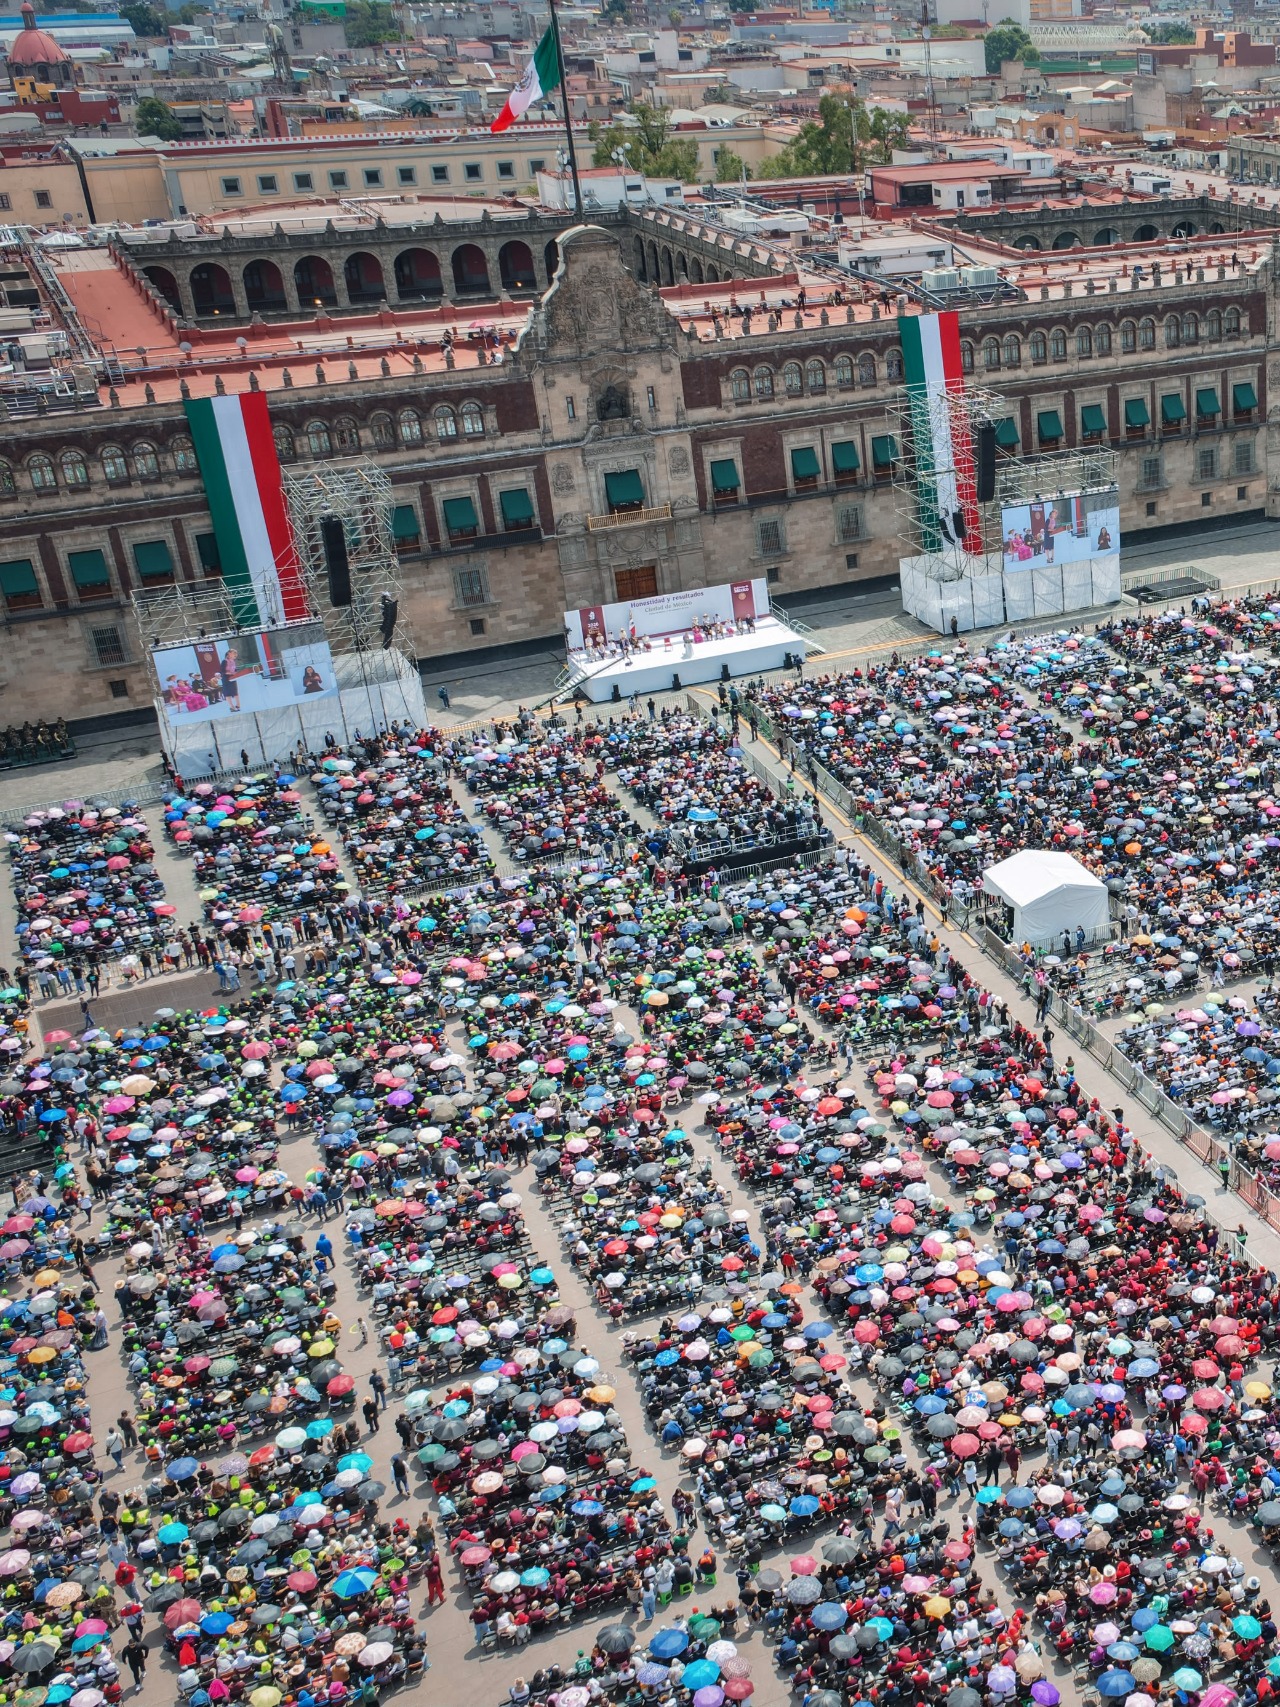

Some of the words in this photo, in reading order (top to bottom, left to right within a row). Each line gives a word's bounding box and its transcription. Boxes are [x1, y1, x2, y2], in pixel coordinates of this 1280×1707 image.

[630, 597, 665, 608] Honestidad
[672, 591, 704, 601] resultados
[644, 605, 664, 613] Ciudad
